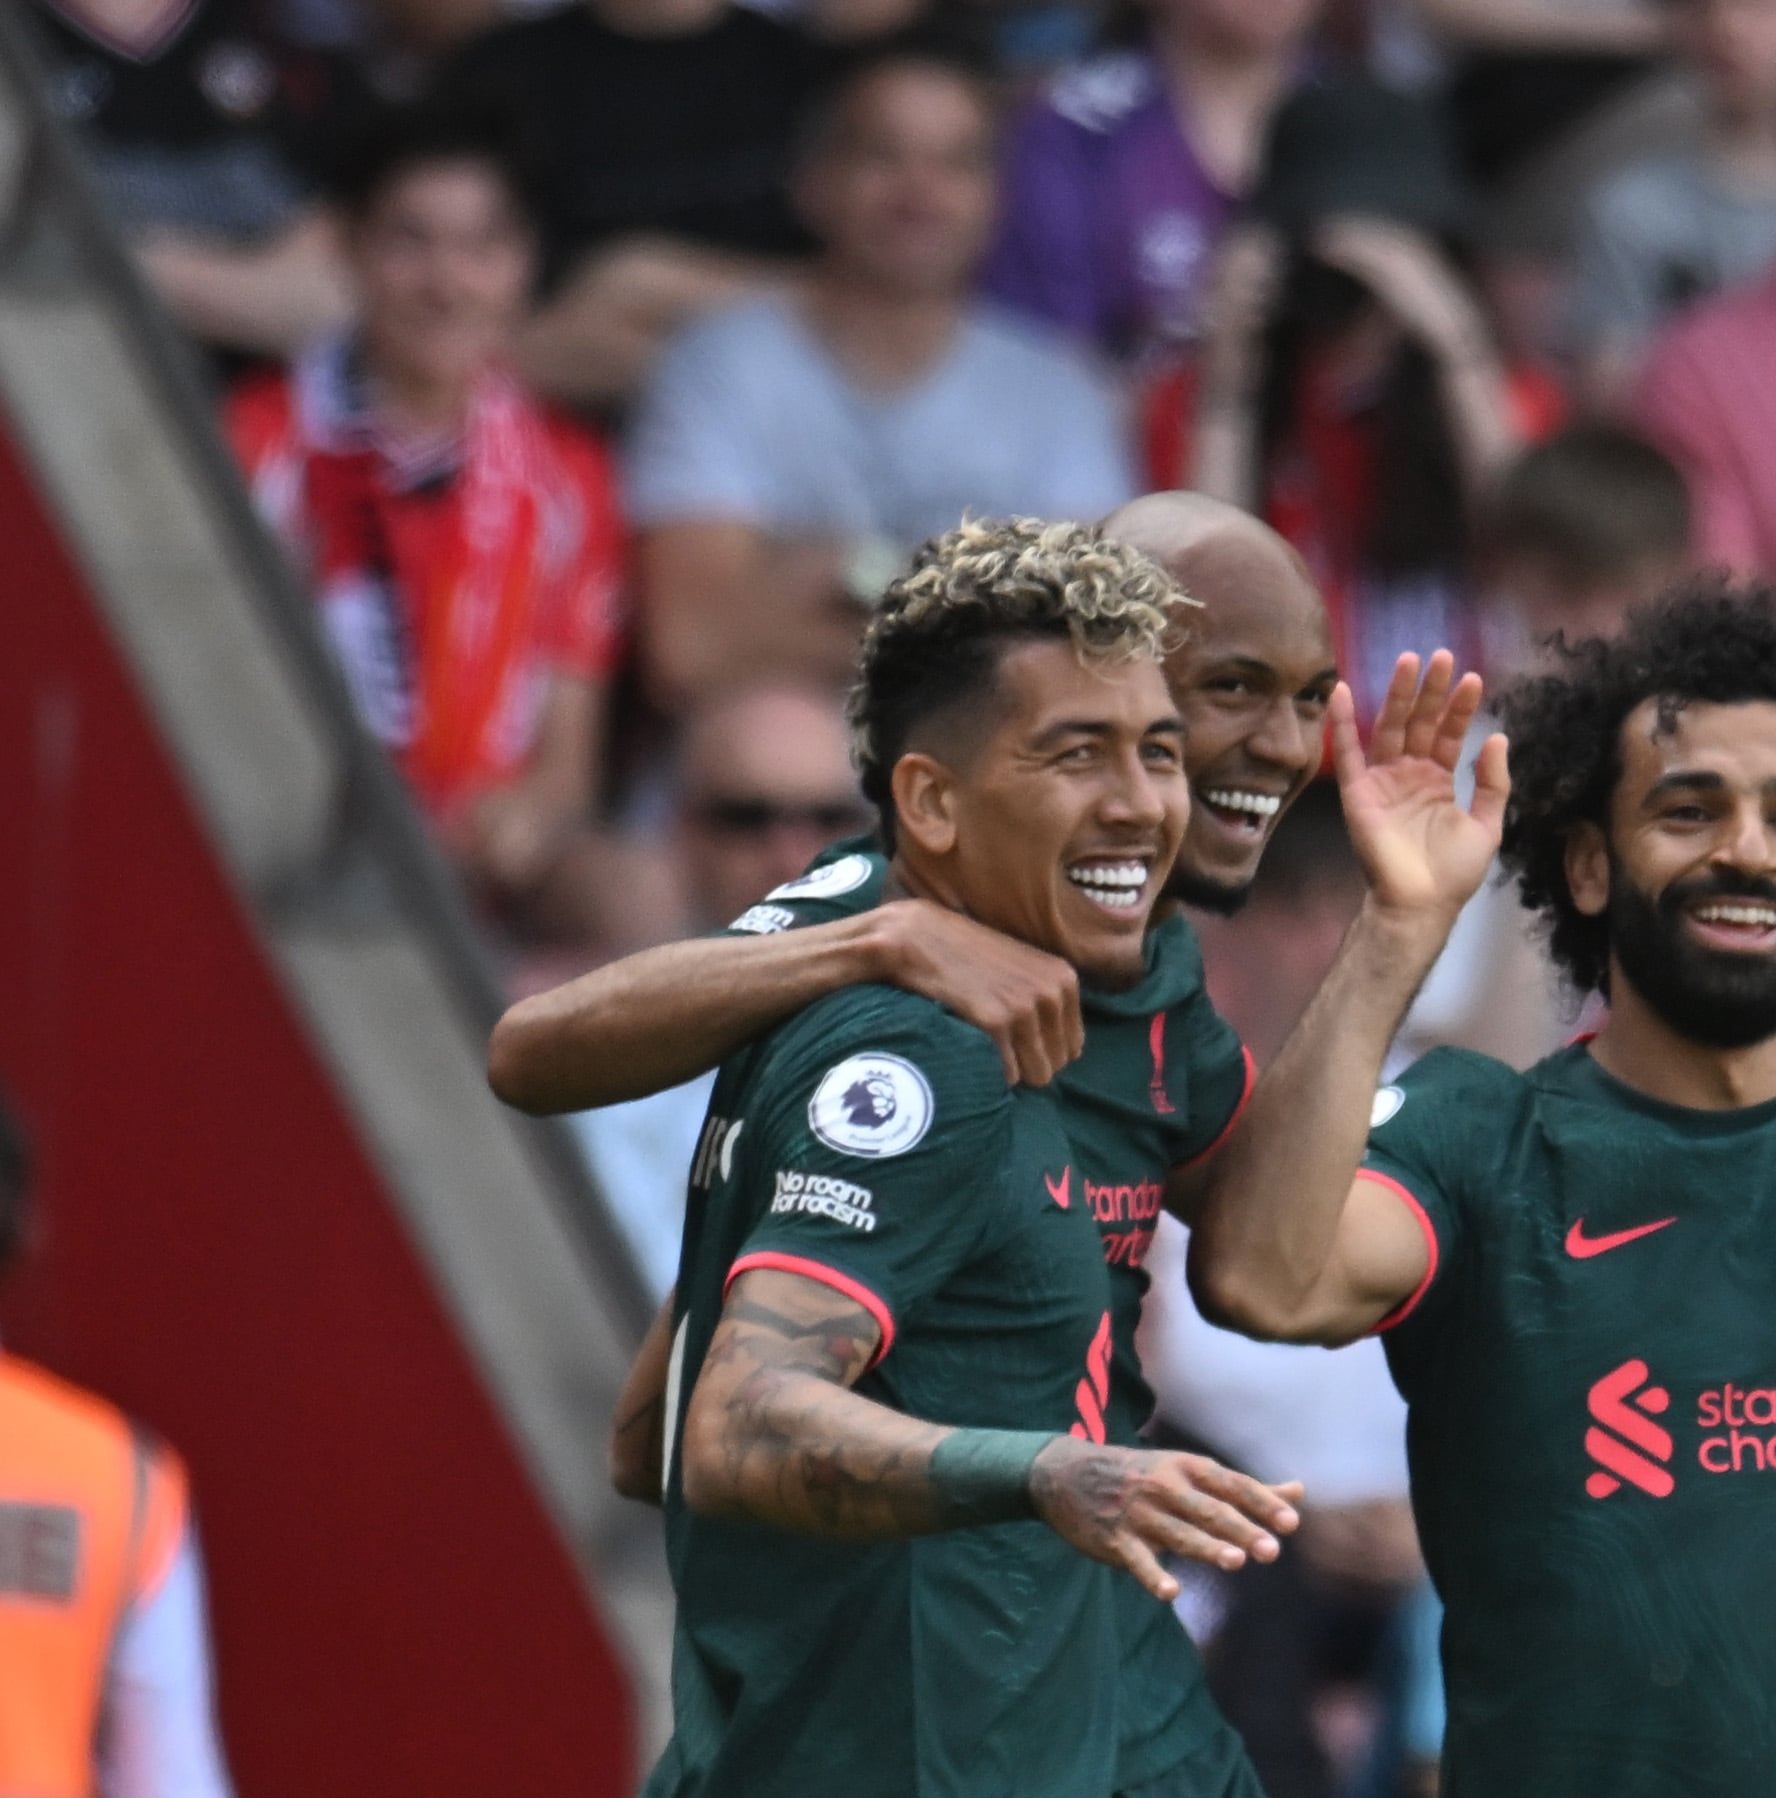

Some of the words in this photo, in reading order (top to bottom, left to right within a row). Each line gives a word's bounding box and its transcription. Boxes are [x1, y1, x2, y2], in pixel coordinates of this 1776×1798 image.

[776, 1171, 803, 1192] No
[804, 1174, 873, 1210] room
[797, 1195, 877, 1232] racism
